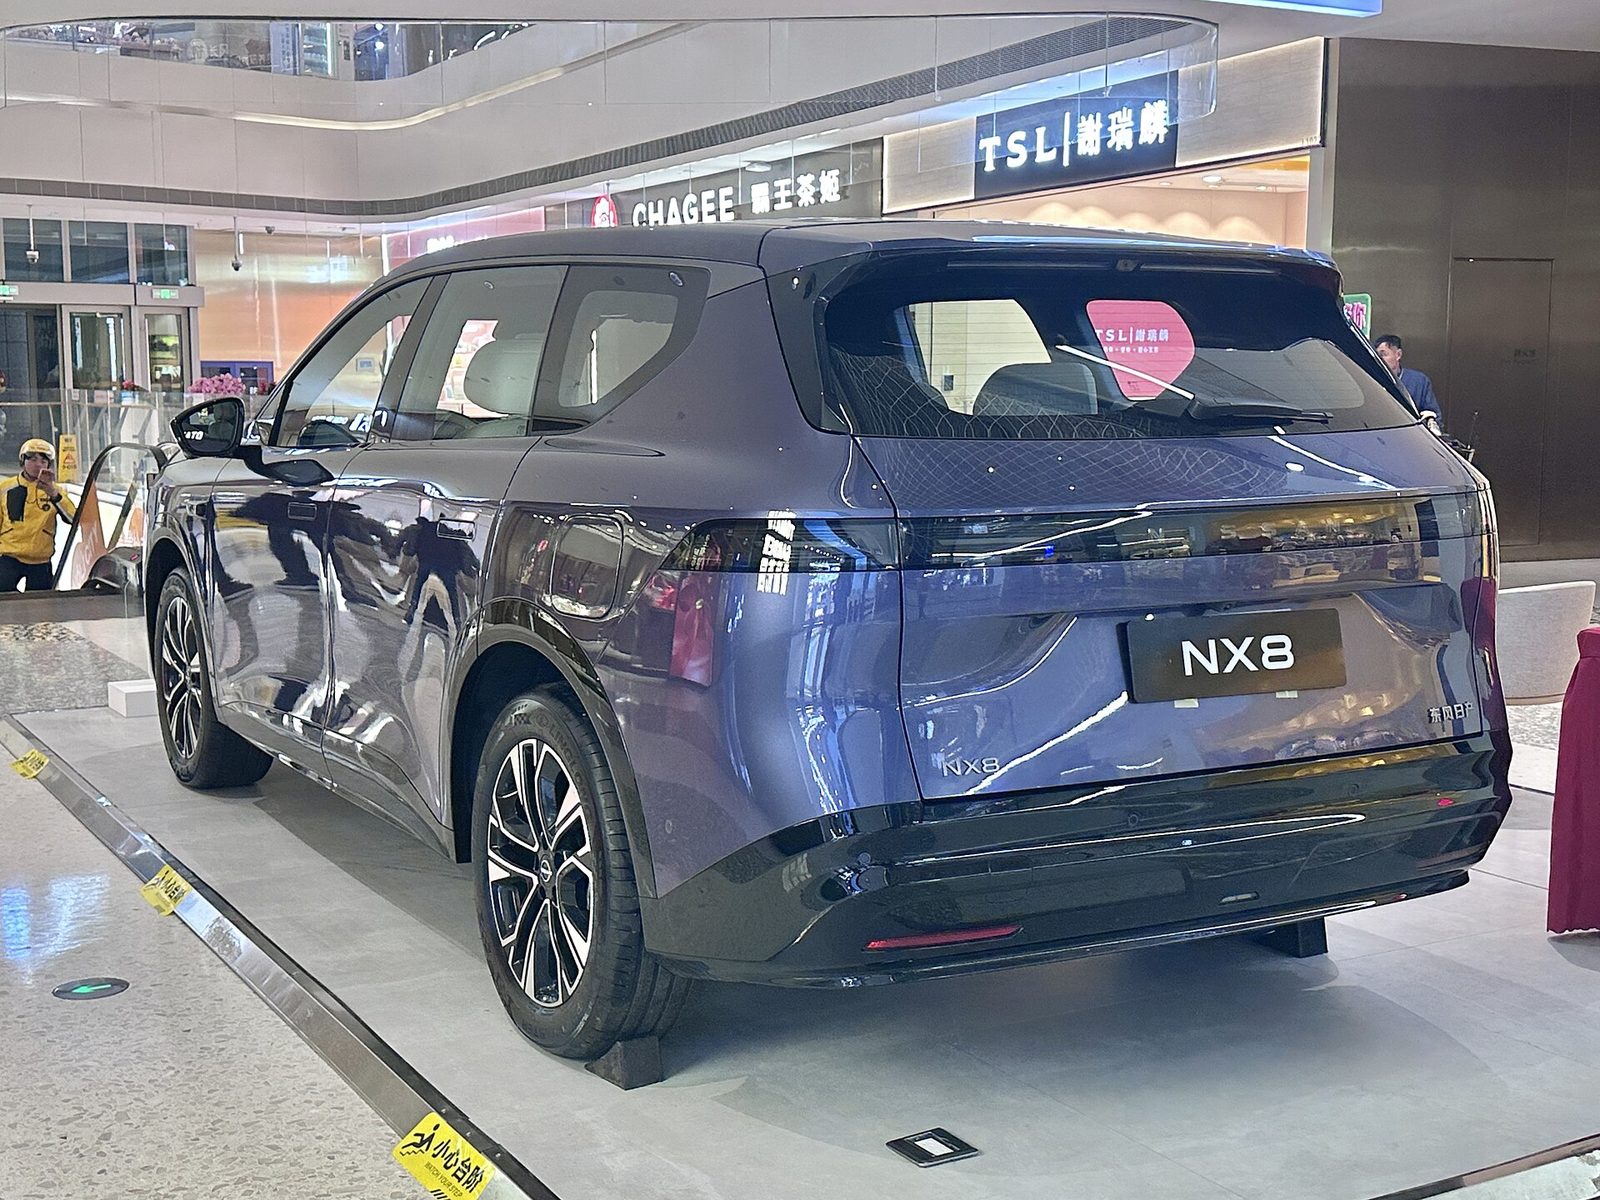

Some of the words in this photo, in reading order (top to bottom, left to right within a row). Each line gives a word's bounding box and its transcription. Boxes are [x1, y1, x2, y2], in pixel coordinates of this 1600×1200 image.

[979, 126, 1058, 172] TSL
[632, 186, 736, 228] CHAGEE
[751, 168, 842, 215] 霸王茶姬
[1094, 328, 1128, 342] TSL
[1181, 634, 1295, 677] NX8
[941, 756, 1000, 777] NX8
[431, 1138, 485, 1194] 小心台阶
[448, 1184, 464, 1198] STEP
